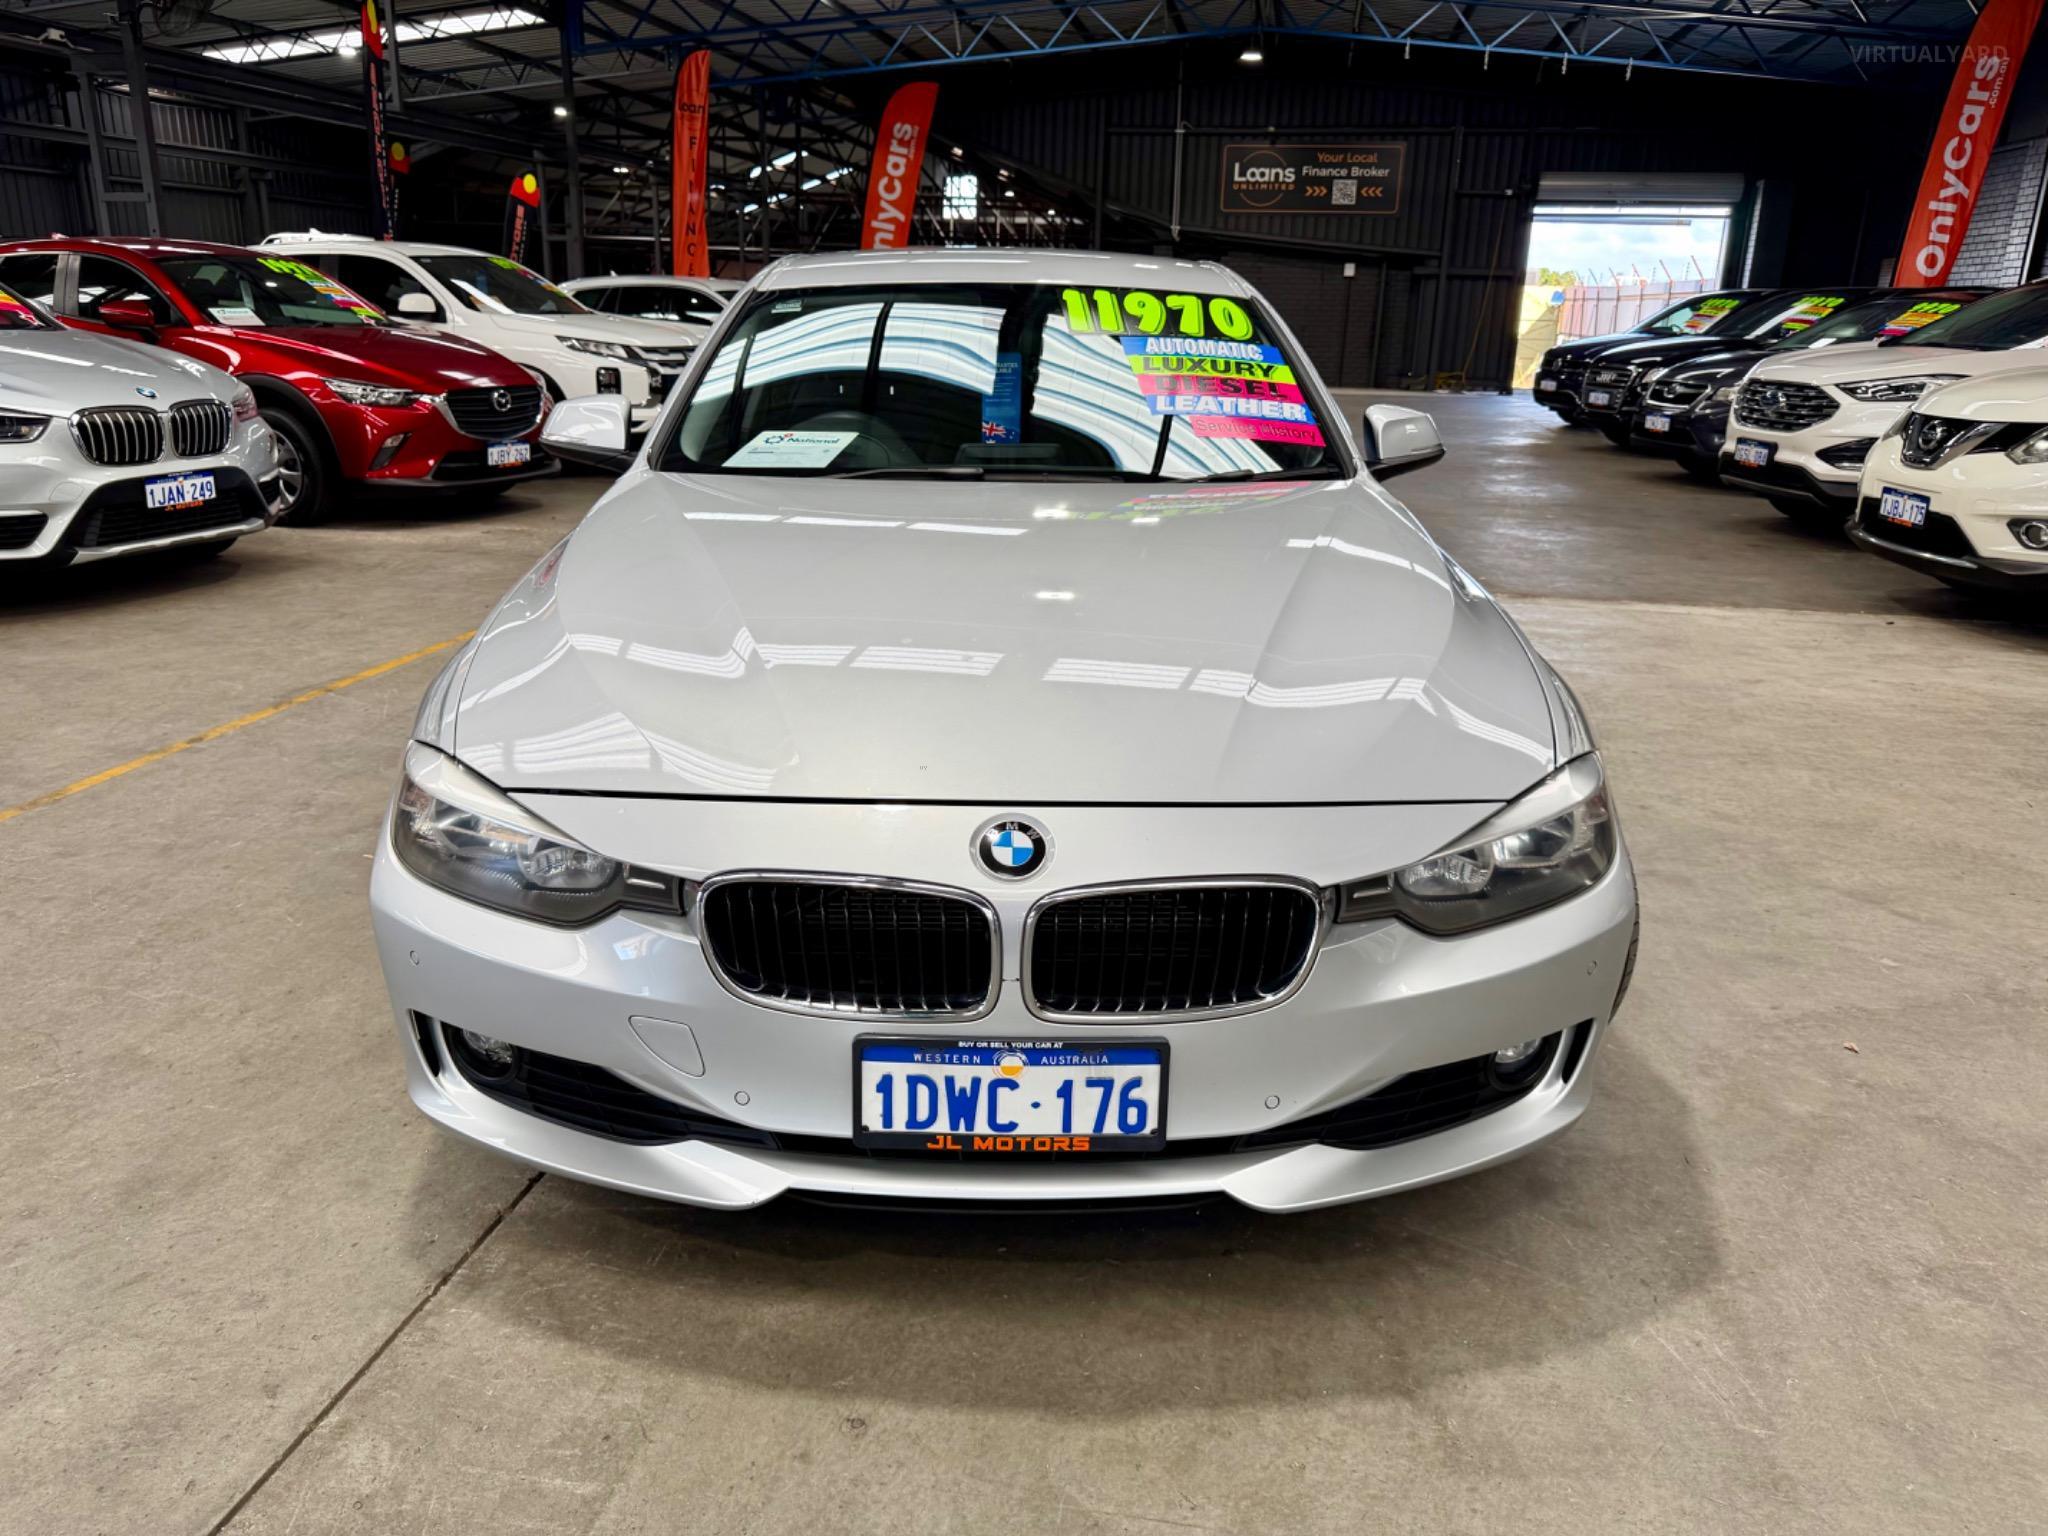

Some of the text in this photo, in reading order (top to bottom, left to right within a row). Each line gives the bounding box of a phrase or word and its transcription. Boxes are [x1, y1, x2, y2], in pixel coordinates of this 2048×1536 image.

[1317, 152, 1378, 163] Your Local
[1233, 162, 1296, 182] Loans
[1302, 166, 1390, 177] Finance Broker
[871, 122, 914, 249] nlyCars
[1062, 289, 1253, 340] 11970
[1145, 336, 1264, 360] AUTOMATIC
[1142, 356, 1280, 379] LUXURY
[1154, 375, 1288, 400] DIESEL
[1156, 395, 1307, 422] LEATHER
[1196, 419, 1256, 435] Service
[1011, 1041, 1034, 1049] YOUR
[913, 1053, 1109, 1065] WESTERN AUSTRALIA
[927, 1135, 1090, 1151] JL MOTORS
